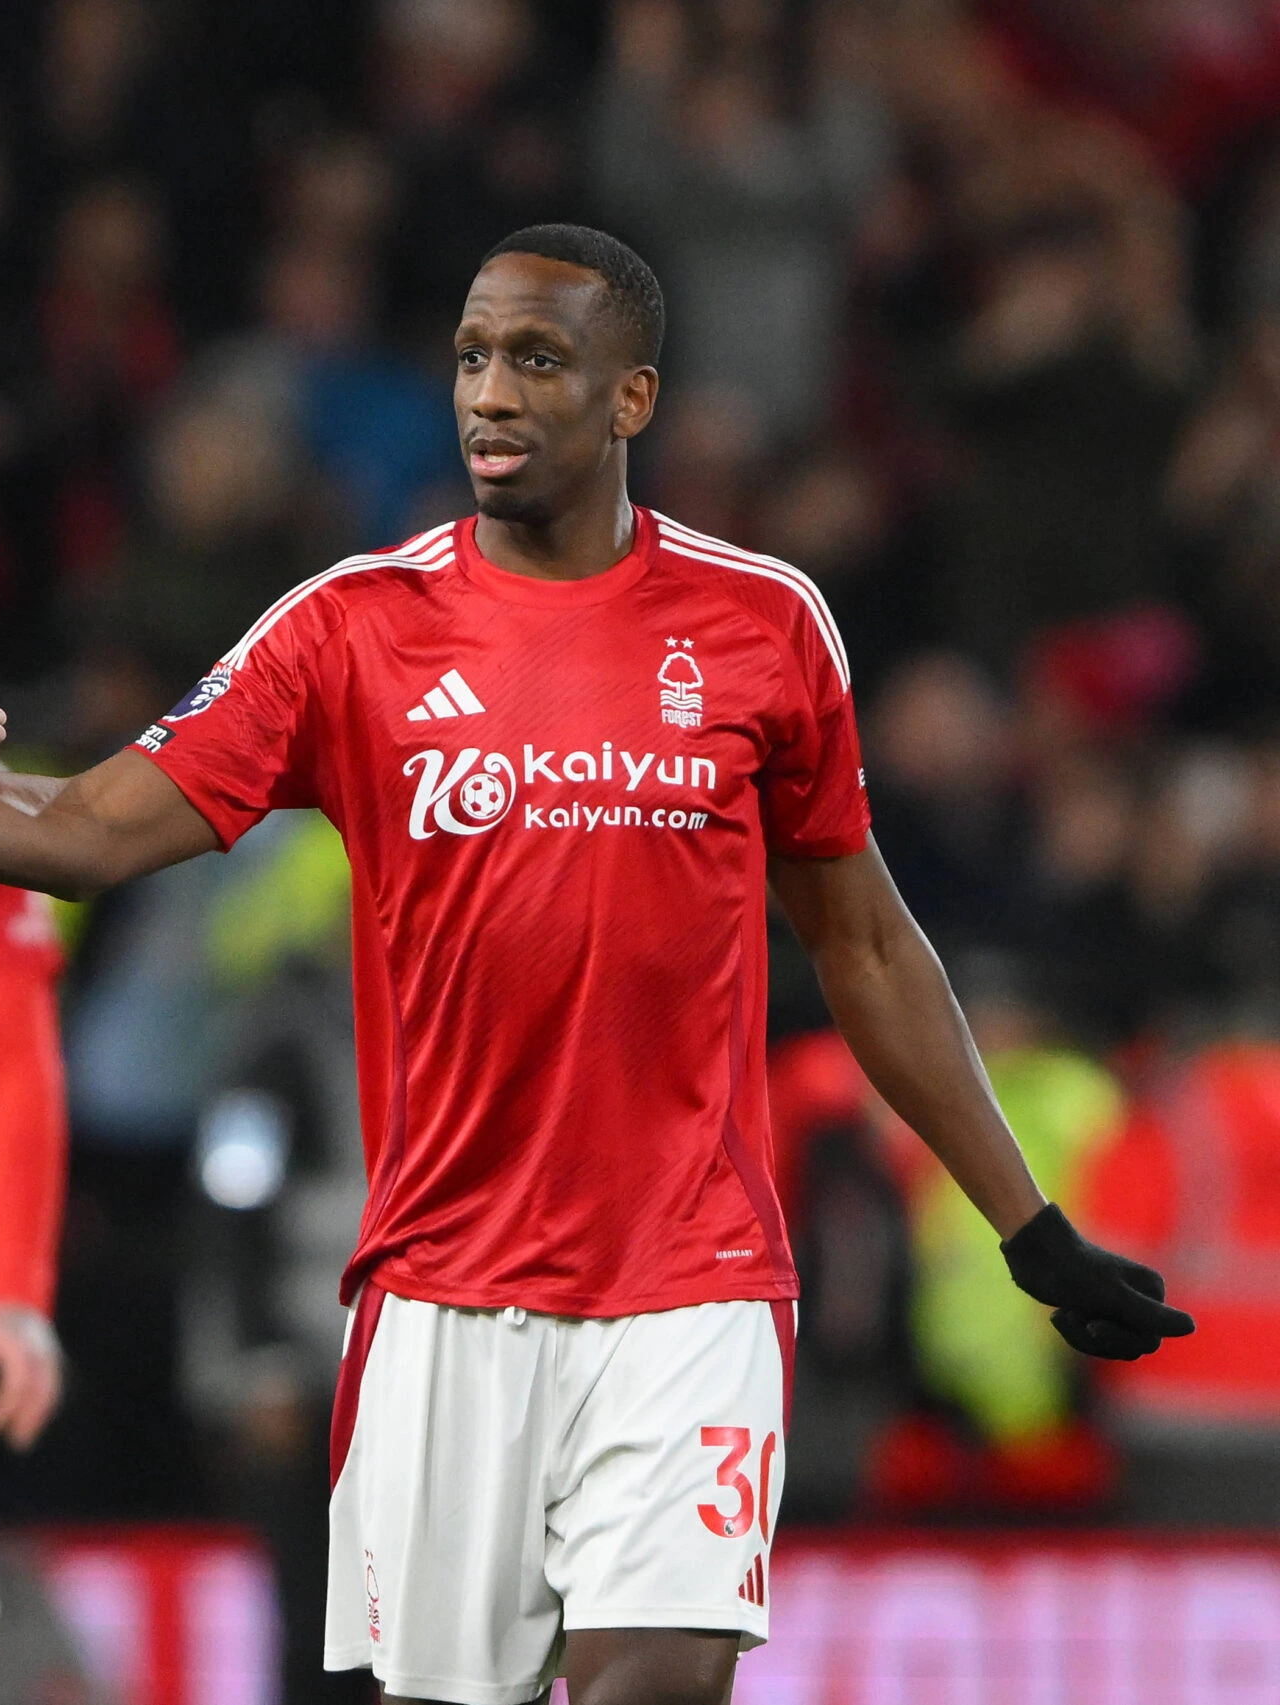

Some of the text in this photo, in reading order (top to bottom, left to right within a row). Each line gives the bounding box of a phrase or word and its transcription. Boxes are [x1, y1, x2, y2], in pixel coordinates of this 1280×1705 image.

[661, 708, 703, 729] FOREST
[523, 741, 717, 791] kaiyun
[524, 801, 708, 832] kaiyun.com
